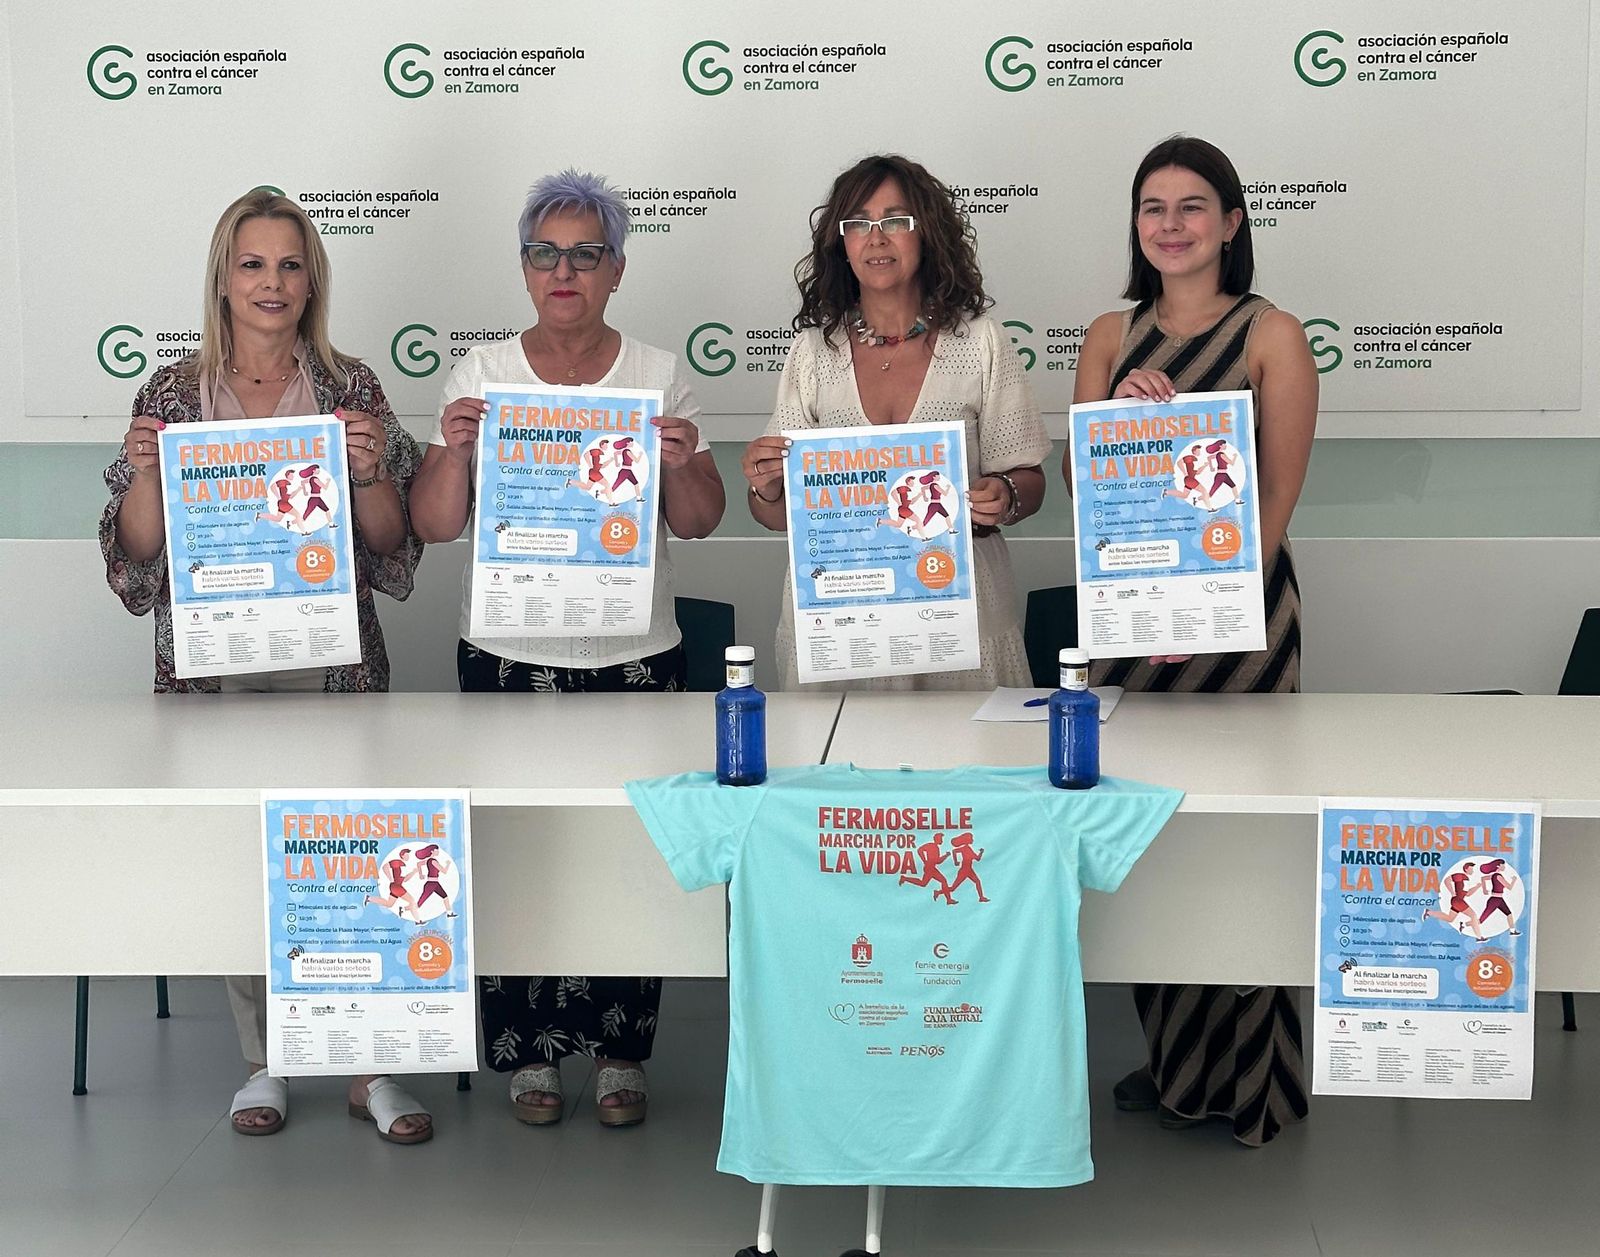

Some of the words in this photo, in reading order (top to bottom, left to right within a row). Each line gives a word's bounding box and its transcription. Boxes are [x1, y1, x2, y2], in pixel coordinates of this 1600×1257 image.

[1047, 40, 1123, 53] asociación
[1127, 38, 1192, 55] española
[1358, 33, 1436, 47] asociación
[1441, 32, 1508, 48] española
[147, 50, 220, 62] asociación
[224, 49, 286, 65] española
[444, 47, 517, 60] asociación
[521, 47, 584, 62] española
[743, 44, 818, 57] asociación
[822, 43, 886, 59] española
[1358, 52, 1405, 64] contra
[1409, 50, 1422, 63] el
[1426, 50, 1477, 63] cáncer
[444, 65, 489, 76] contra
[492, 64, 504, 76] el
[508, 64, 556, 76] cáncer
[743, 62, 789, 74] contra
[792, 61, 804, 73] el
[808, 60, 857, 73] cáncer
[1047, 58, 1093, 69] contra
[1097, 56, 1109, 69] el
[1113, 56, 1162, 69] cáncer
[147, 67, 192, 78] contra
[195, 66, 207, 78] el
[211, 66, 258, 78] cáncer
[1357, 72, 1375, 81] en
[1379, 69, 1436, 81] Zamora
[445, 84, 461, 94] en
[465, 81, 519, 93] Zamora
[744, 81, 760, 90] en
[765, 78, 819, 90] Zamora
[1047, 77, 1064, 86] en
[1068, 74, 1123, 86] Zamora
[148, 86, 164, 95] en
[168, 83, 222, 95] Zamora
[673, 187, 736, 203] española
[974, 184, 1038, 200] española
[1281, 180, 1346, 196] española
[299, 190, 372, 202] asociación
[376, 189, 439, 205] española
[1250, 198, 1262, 210] el
[1266, 198, 1316, 210] cáncer
[304, 207, 344, 218] ontra
[348, 206, 359, 218] el
[363, 206, 410, 218] cáncer
[644, 204, 656, 216] el
[660, 204, 707, 216] cáncer
[961, 201, 1009, 214] cáncer
[320, 223, 373, 235] Zamora
[1354, 323, 1431, 335] asociación
[1436, 322, 1502, 338] española
[1354, 340, 1400, 352] contra
[1405, 339, 1417, 351] el
[1421, 339, 1472, 351] cáncer
[747, 363, 763, 372] en
[1047, 361, 1064, 370] en
[1354, 360, 1371, 368] en
[1375, 357, 1431, 368] Zamora
[500, 405, 642, 432] FERMOSELLE
[499, 428, 551, 442] MARCHA
[556, 430, 582, 443] POR
[1088, 412, 1232, 444] FERMOSELLE
[179, 437, 326, 466] FERMOSELLE
[498, 442, 525, 464] LA
[532, 443, 580, 465] VIDA
[1090, 442, 1145, 458] MARCHA
[1148, 440, 1173, 453] POR
[802, 444, 945, 473] FERMOSELLE
[182, 466, 237, 480] MARCHA
[240, 464, 266, 476] POR
[535, 466, 543, 475] el
[1091, 459, 1119, 480] LA
[1125, 455, 1174, 478] VIDA
[804, 472, 858, 487] MARCHA
[861, 470, 887, 483] POR
[182, 480, 211, 503] LA
[217, 478, 268, 500] VIDA
[806, 488, 832, 510] LA
[838, 485, 888, 507] VIDA
[222, 503, 232, 512] el
[844, 510, 852, 518] el
[819, 807, 972, 830] FERMOSELLE
[284, 814, 446, 839] FERMOSELLE
[819, 833, 882, 848] MARCHA
[887, 834, 916, 848] POR
[1341, 824, 1514, 852] FERMOSELLE
[285, 840, 346, 854] MARCHA
[350, 840, 379, 854] POR
[820, 850, 852, 874] LA
[859, 850, 917, 874] VIDA
[1341, 850, 1405, 866] MARCHA
[1411, 851, 1441, 866] POR
[285, 857, 316, 880] LA
[322, 856, 379, 880] VIDA
[1340, 866, 1373, 891] LA
[1382, 868, 1440, 893] VIDA
[328, 884, 338, 893] el
[1385, 896, 1395, 905] el
[924, 1015, 947, 1023] CAJA
